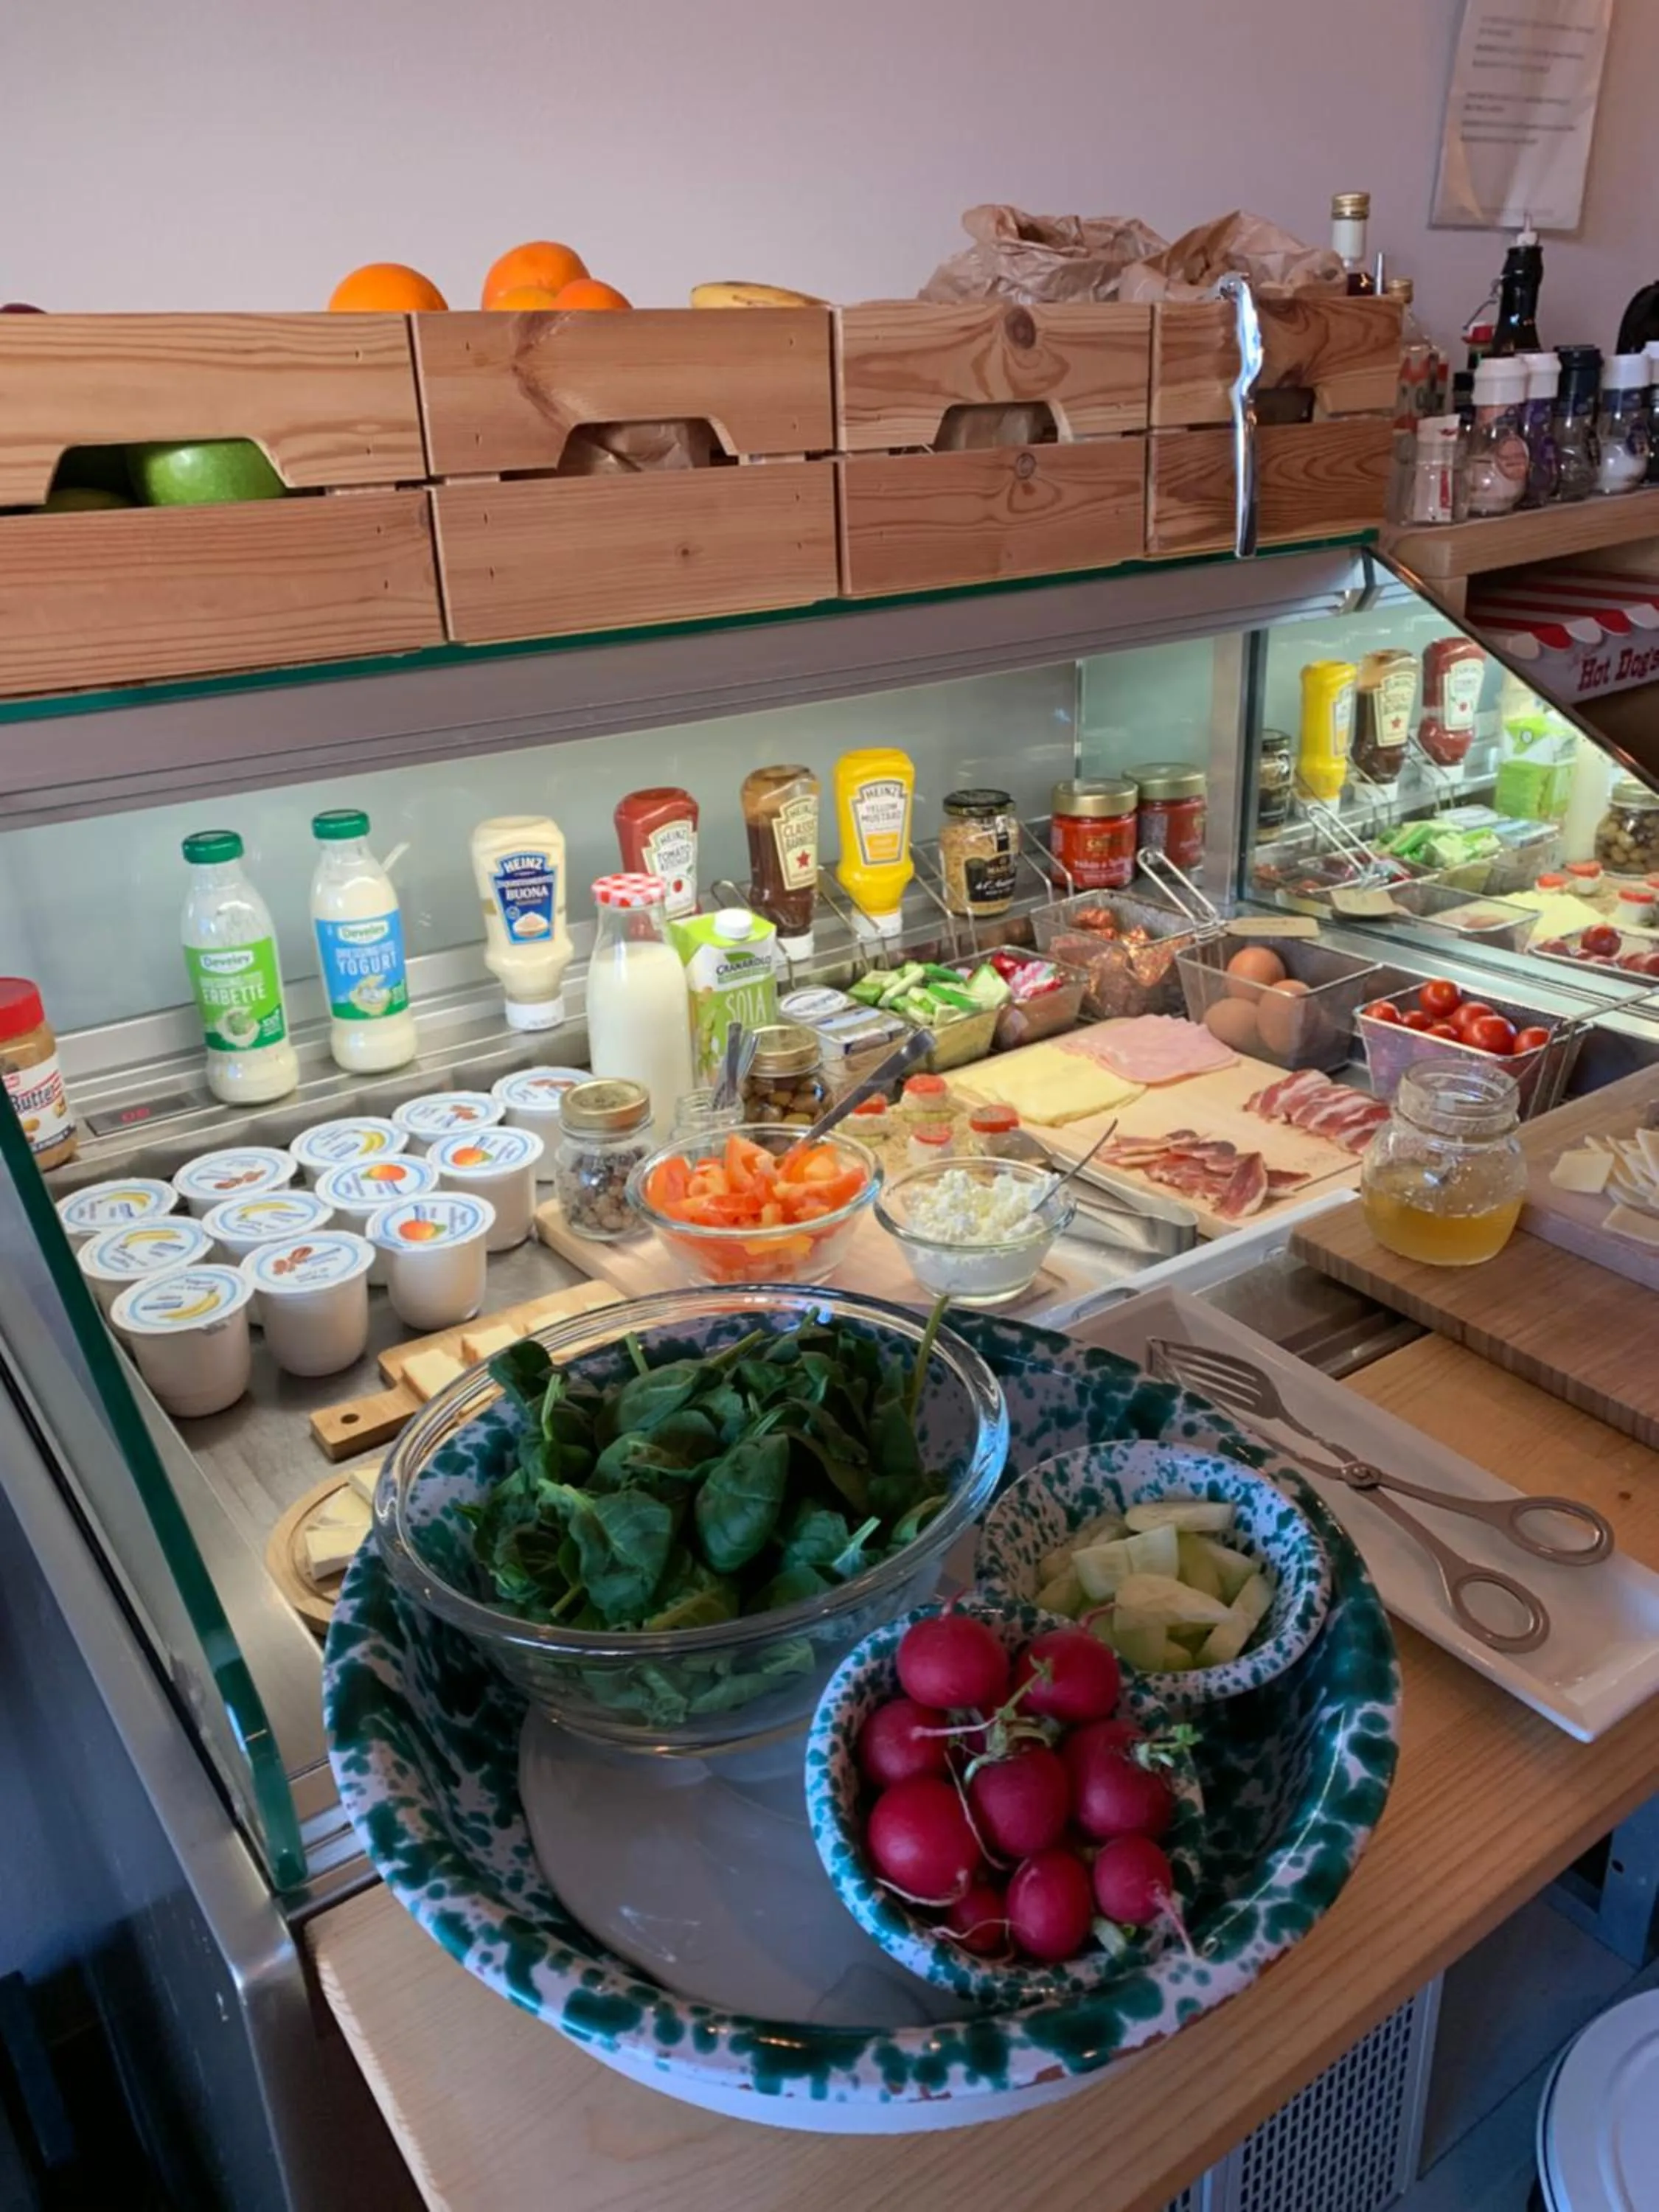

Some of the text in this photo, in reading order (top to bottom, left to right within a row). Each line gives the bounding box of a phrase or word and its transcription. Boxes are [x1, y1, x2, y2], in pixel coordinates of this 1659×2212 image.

[1577, 655, 1611, 692] Hot
[504, 857, 544, 874] HEINZ
[506, 885, 549, 901] BUONA
[336, 949, 397, 977] YOGURT
[202, 984, 267, 1006] ERBETTE
[726, 986, 767, 1026] SOIA
